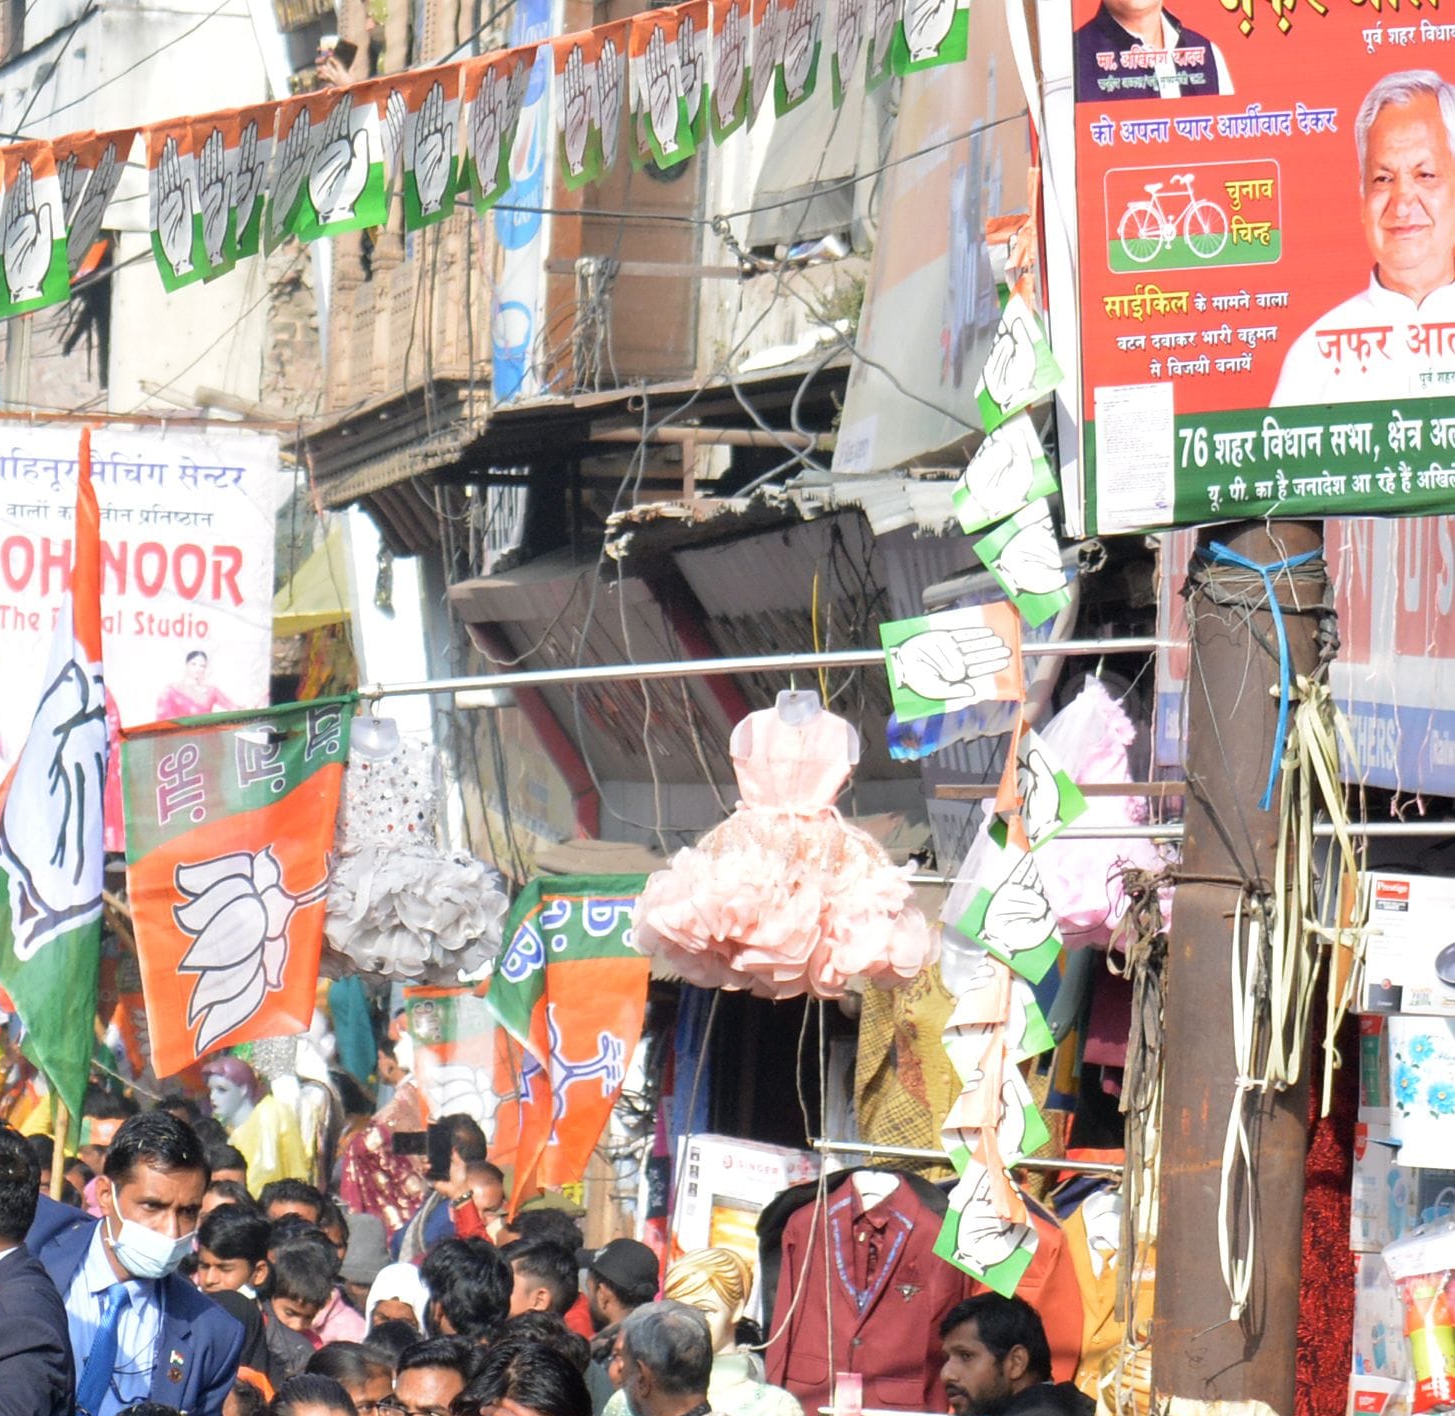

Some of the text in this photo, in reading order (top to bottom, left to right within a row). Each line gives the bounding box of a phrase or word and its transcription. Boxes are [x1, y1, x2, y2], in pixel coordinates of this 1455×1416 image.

[1362, 20, 1383, 54] पूर्व
[1387, 27, 1416, 46] शहर
[1091, 116, 1114, 144] को
[1120, 118, 1169, 143] अपना
[1175, 115, 1214, 141] प्यार
[1296, 103, 1337, 135] देकर
[1225, 179, 1274, 211] चुनाव
[1230, 215, 1272, 246] चिन्ह
[1103, 284, 1289, 322] साईकिल के सामने वाला
[1202, 324, 1233, 346] भारी
[1150, 358, 1162, 378] से
[1167, 353, 1210, 377] विजयी
[1179, 427, 1209, 468] 76
[1213, 430, 1257, 467] शहर
[1262, 416, 1324, 461] विधान
[1330, 422, 1381, 463] सभा,
[1388, 409, 1423, 452] क्षेत्र
[90, 449, 168, 485] मैचिंग
[1207, 485, 1223, 512] यू.
[1229, 475, 1249, 502] पी.
[1255, 480, 1273, 498] का
[1277, 469, 1289, 501] है
[1292, 470, 1346, 497] जनादेश
[1352, 473, 1371, 493] आ
[1376, 466, 1397, 493] रहे
[1400, 461, 1413, 494] हैं
[134, 610, 209, 639] Studio
